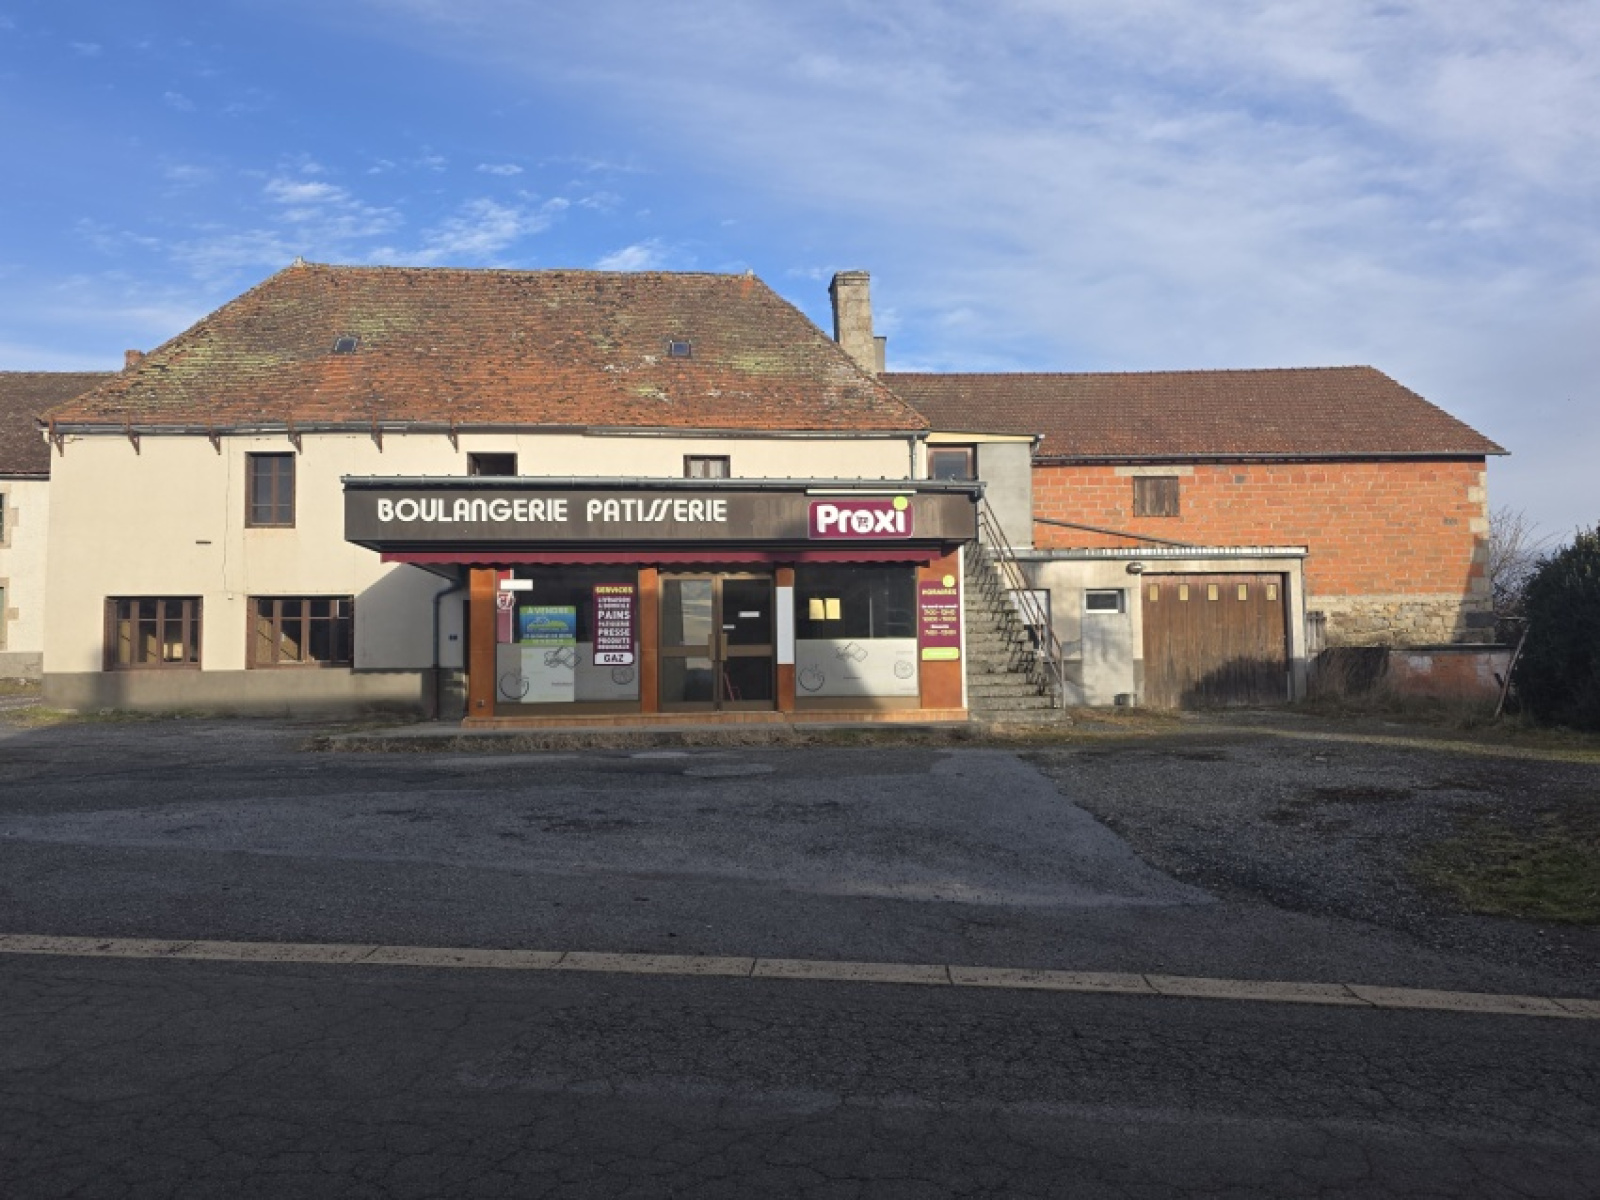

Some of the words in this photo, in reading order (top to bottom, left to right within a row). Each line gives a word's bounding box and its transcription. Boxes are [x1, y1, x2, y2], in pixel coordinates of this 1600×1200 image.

[377, 498, 568, 522] BOULANGERIE
[586, 498, 728, 522] PATISSERIE
[816, 496, 907, 534] Proxi
[598, 610, 632, 620] PAINS
[598, 628, 631, 637] PRESSE
[603, 654, 624, 663] GAZ
